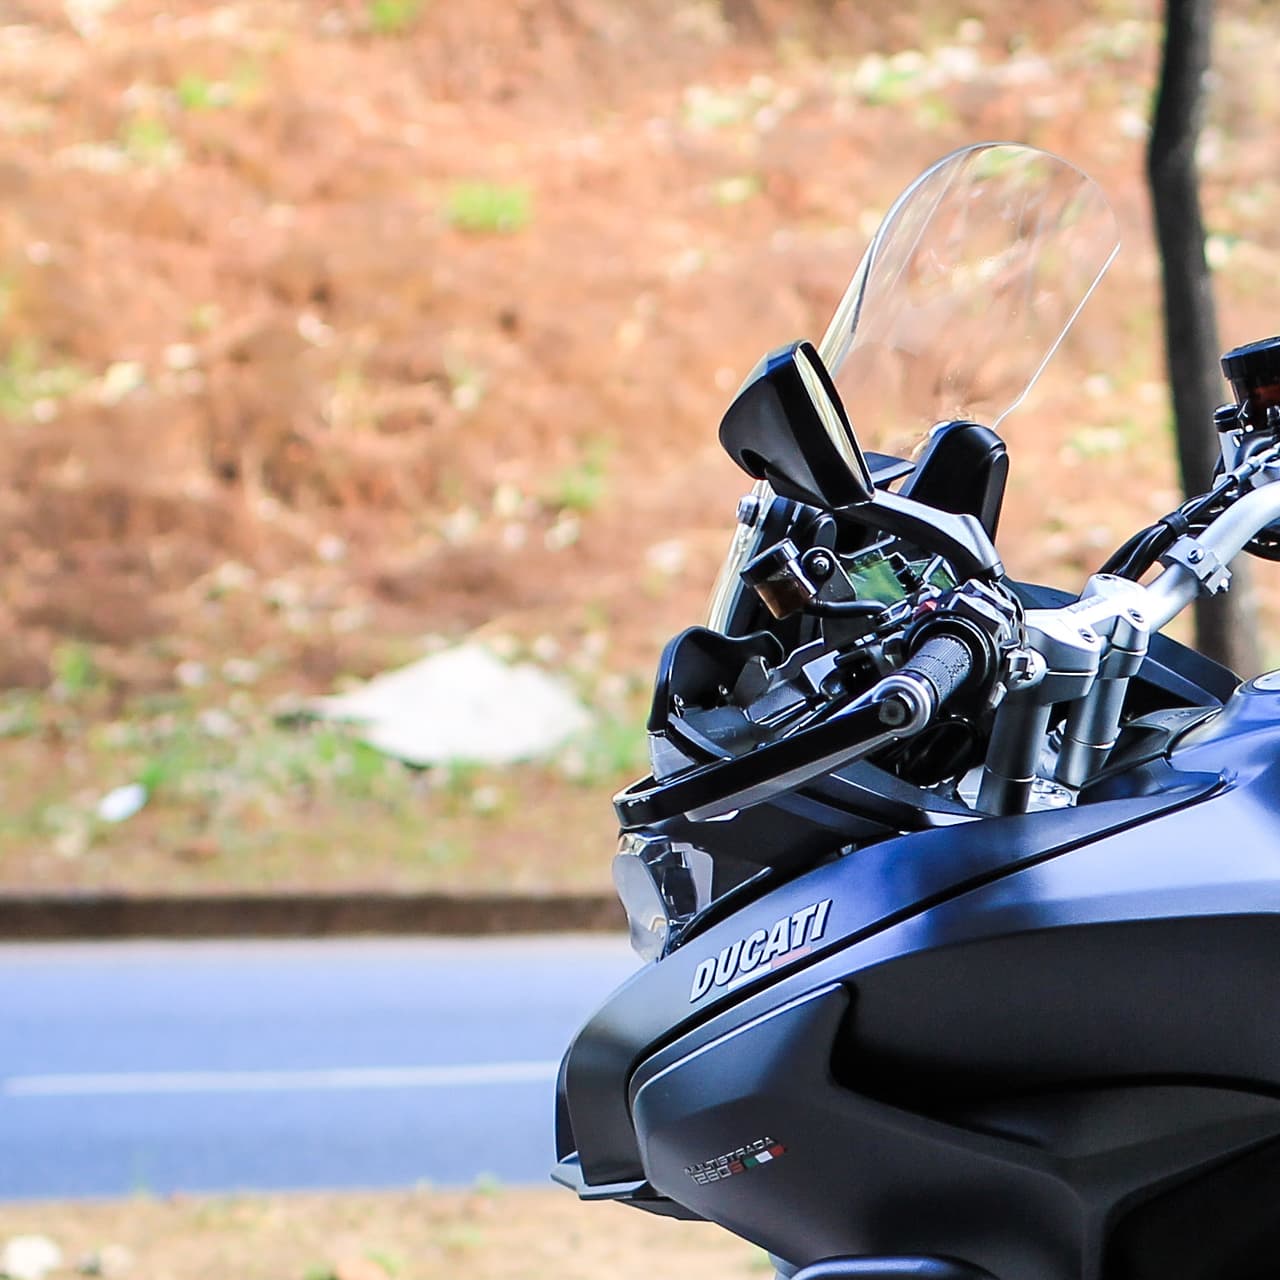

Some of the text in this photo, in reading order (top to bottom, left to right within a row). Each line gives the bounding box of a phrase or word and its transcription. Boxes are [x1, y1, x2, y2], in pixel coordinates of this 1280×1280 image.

[690, 898, 833, 1003] DUCATI
[684, 1137, 776, 1174] MULTISTRADA
[691, 1161, 745, 1185] 1260S
